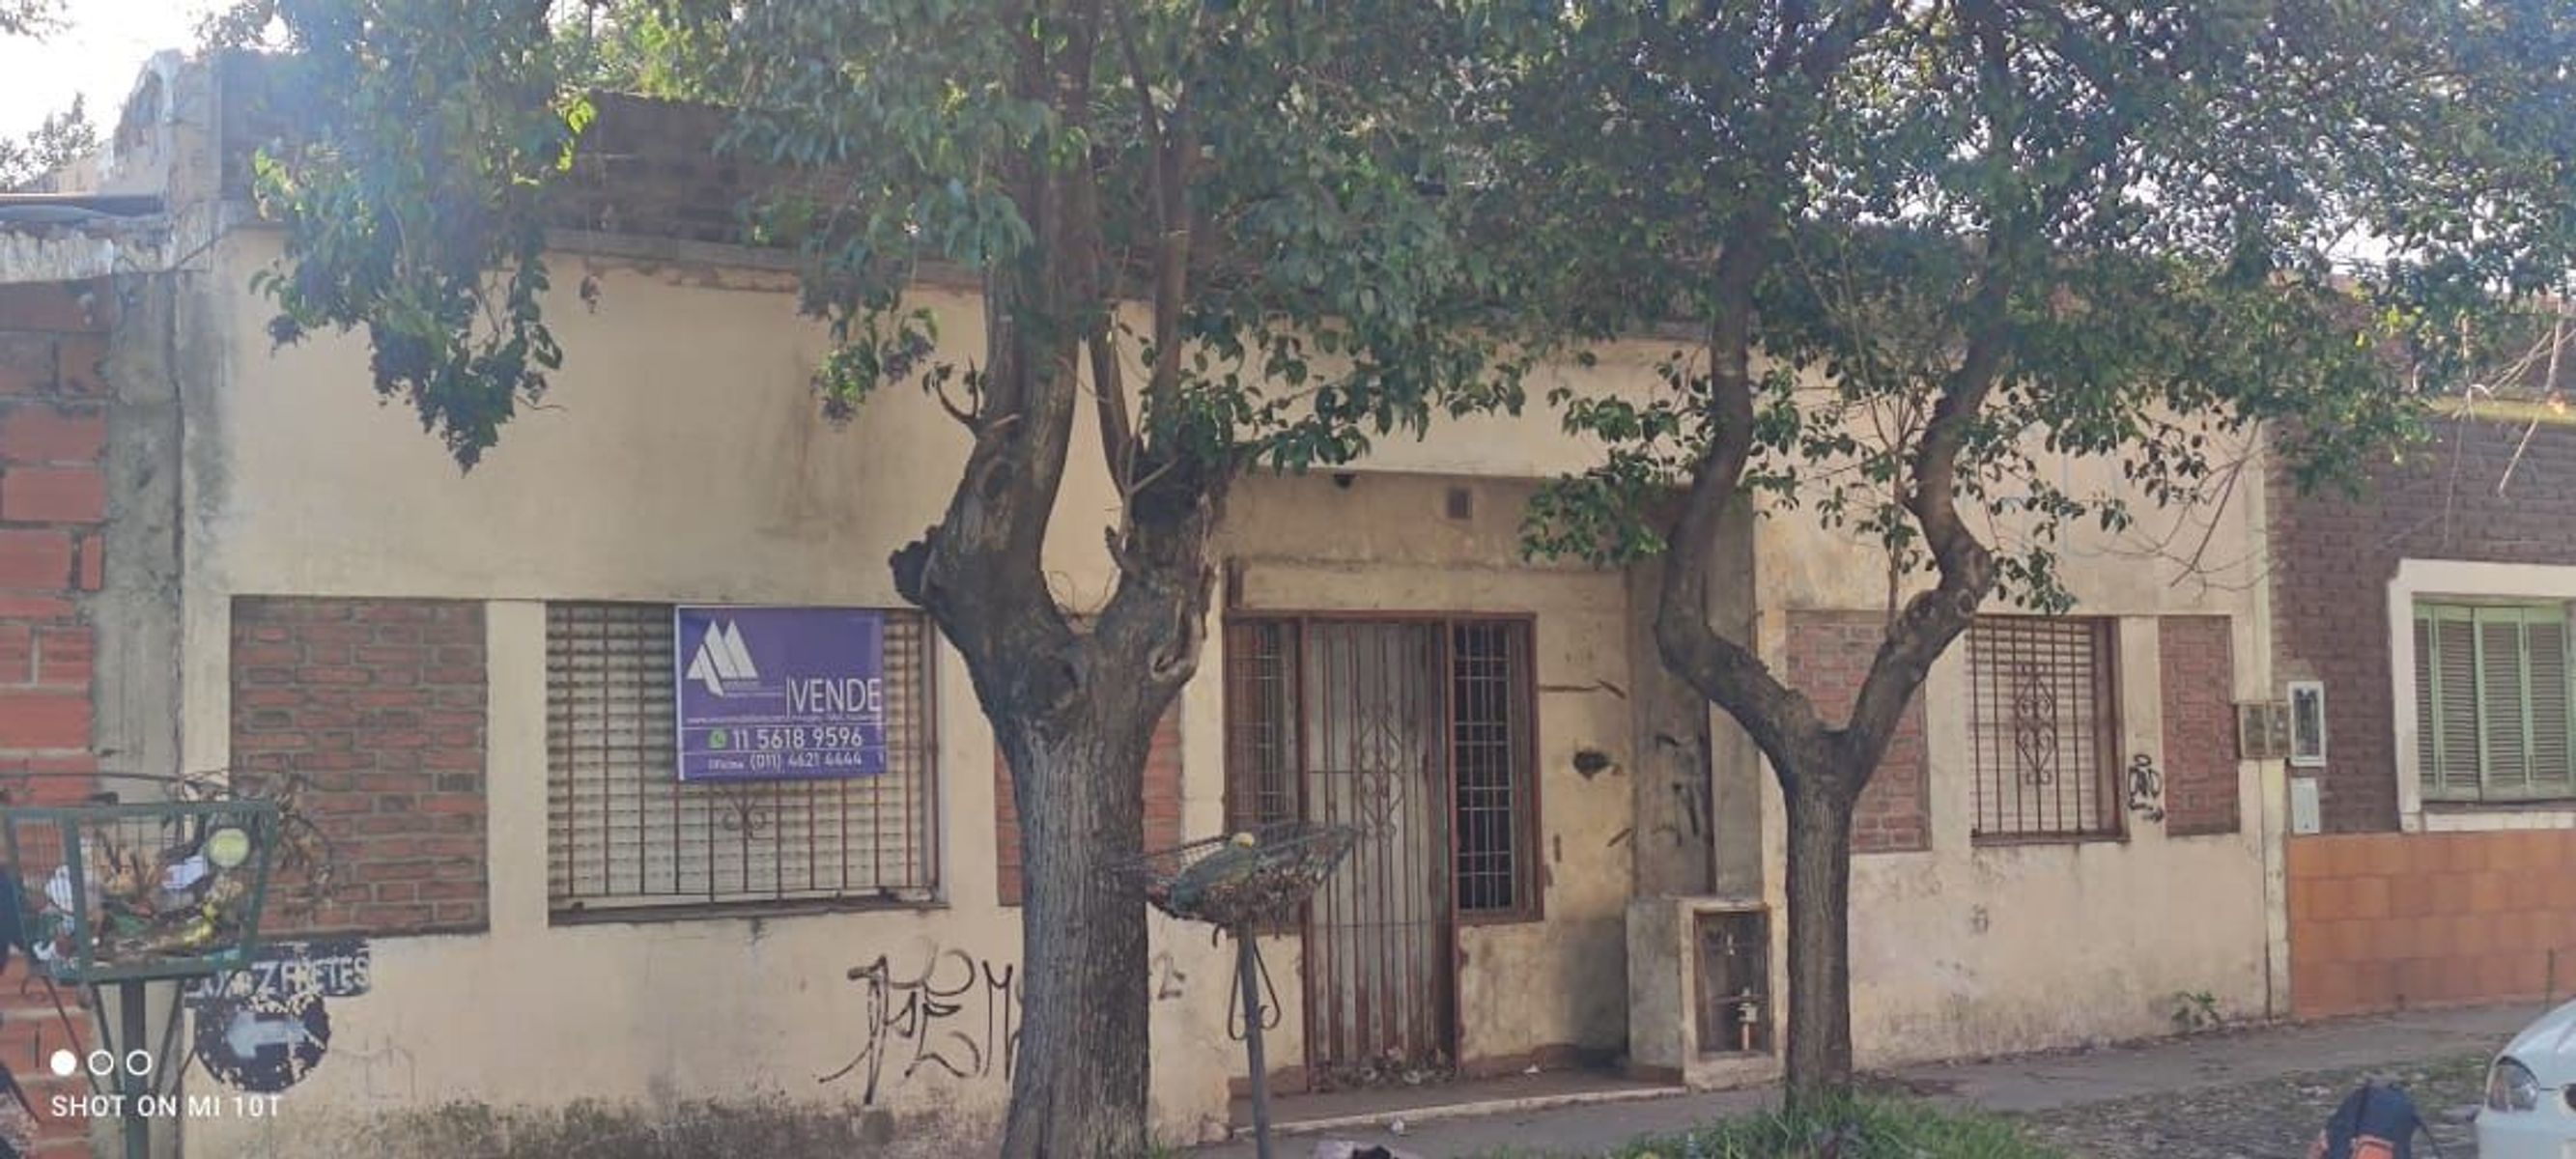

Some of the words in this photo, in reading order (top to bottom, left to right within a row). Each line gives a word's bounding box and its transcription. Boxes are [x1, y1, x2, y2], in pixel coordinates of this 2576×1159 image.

[791, 677, 882, 713] VENDE
[733, 728, 749, 750] 11
[756, 727, 805, 749] 5618
[812, 726, 863, 749] 9596
[788, 751, 821, 767] 4621
[825, 750, 863, 766] 4444
